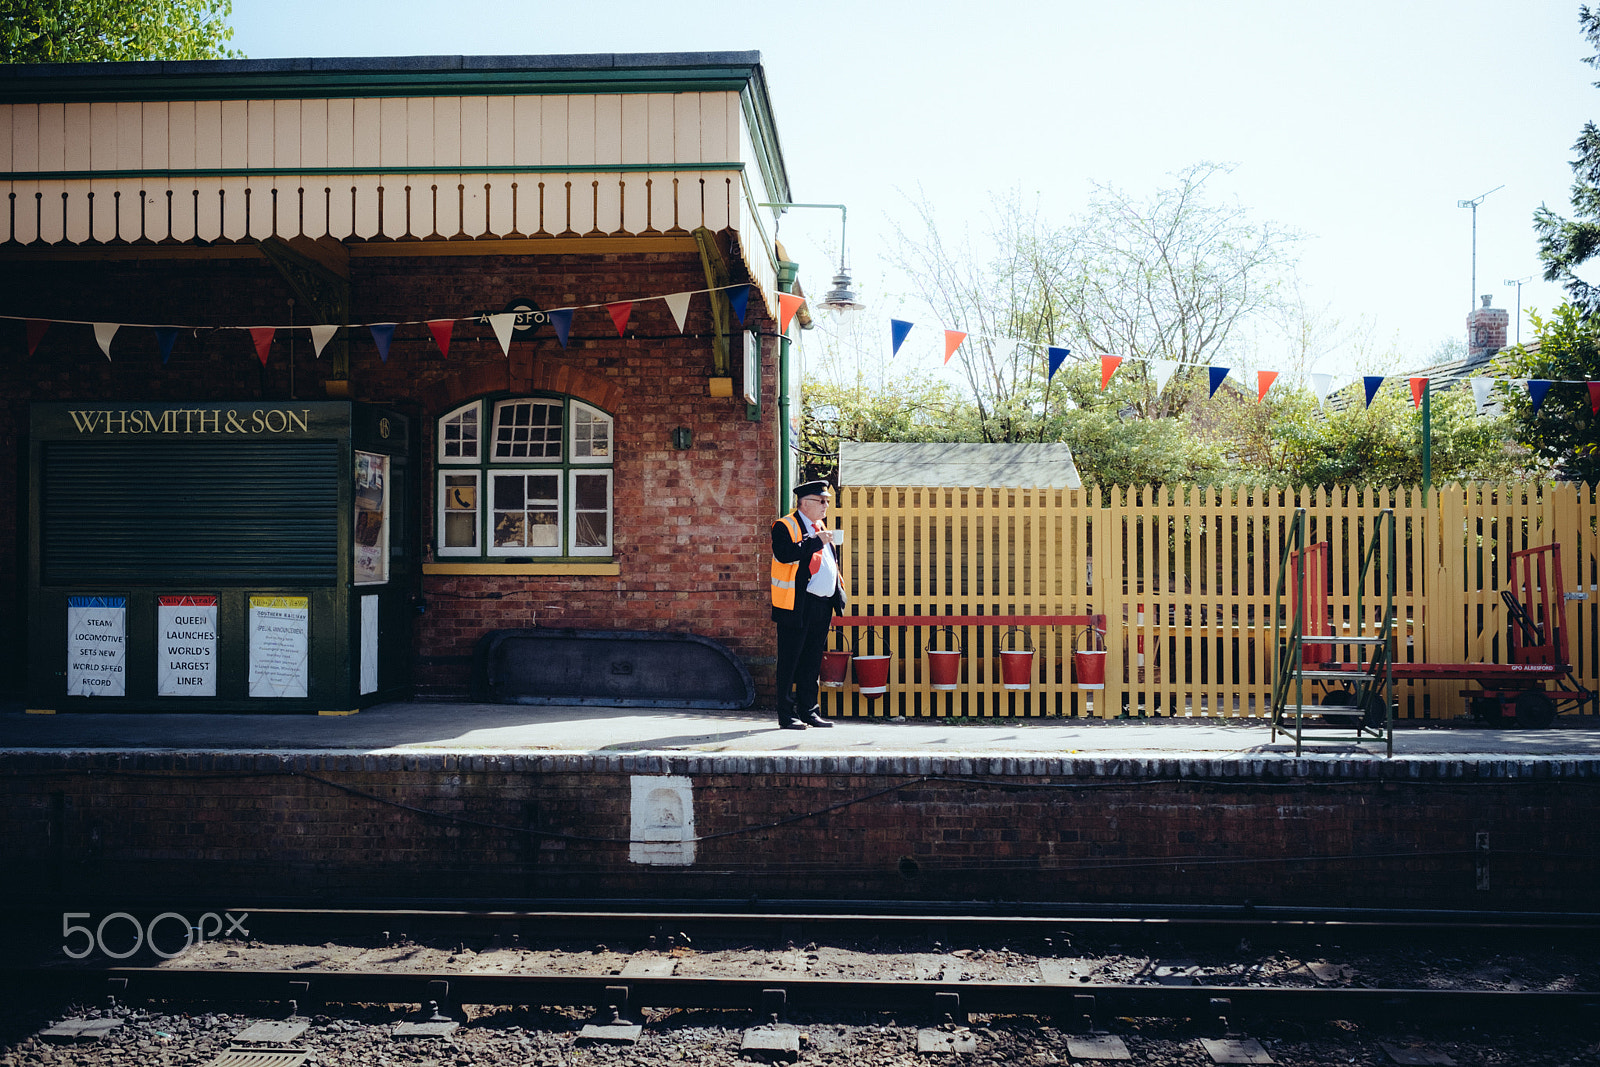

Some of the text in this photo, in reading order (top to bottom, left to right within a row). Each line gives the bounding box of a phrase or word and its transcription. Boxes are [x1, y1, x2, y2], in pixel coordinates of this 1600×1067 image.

[224, 411, 247, 434] &
[251, 409, 310, 434] SON
[87, 619, 112, 627] STEAM
[175, 616, 207, 625] QUEEN
[75, 634, 123, 643] LOCOMOTIVE
[166, 631, 214, 640] LAUNCHES
[80, 648, 116, 657] SETS NEW
[168, 646, 210, 655] WORLD'S
[73, 663, 123, 672] WORLD SPEED
[170, 661, 210, 670] LARGEST
[82, 678, 111, 687] RECORD
[177, 676, 203, 686] LINER
